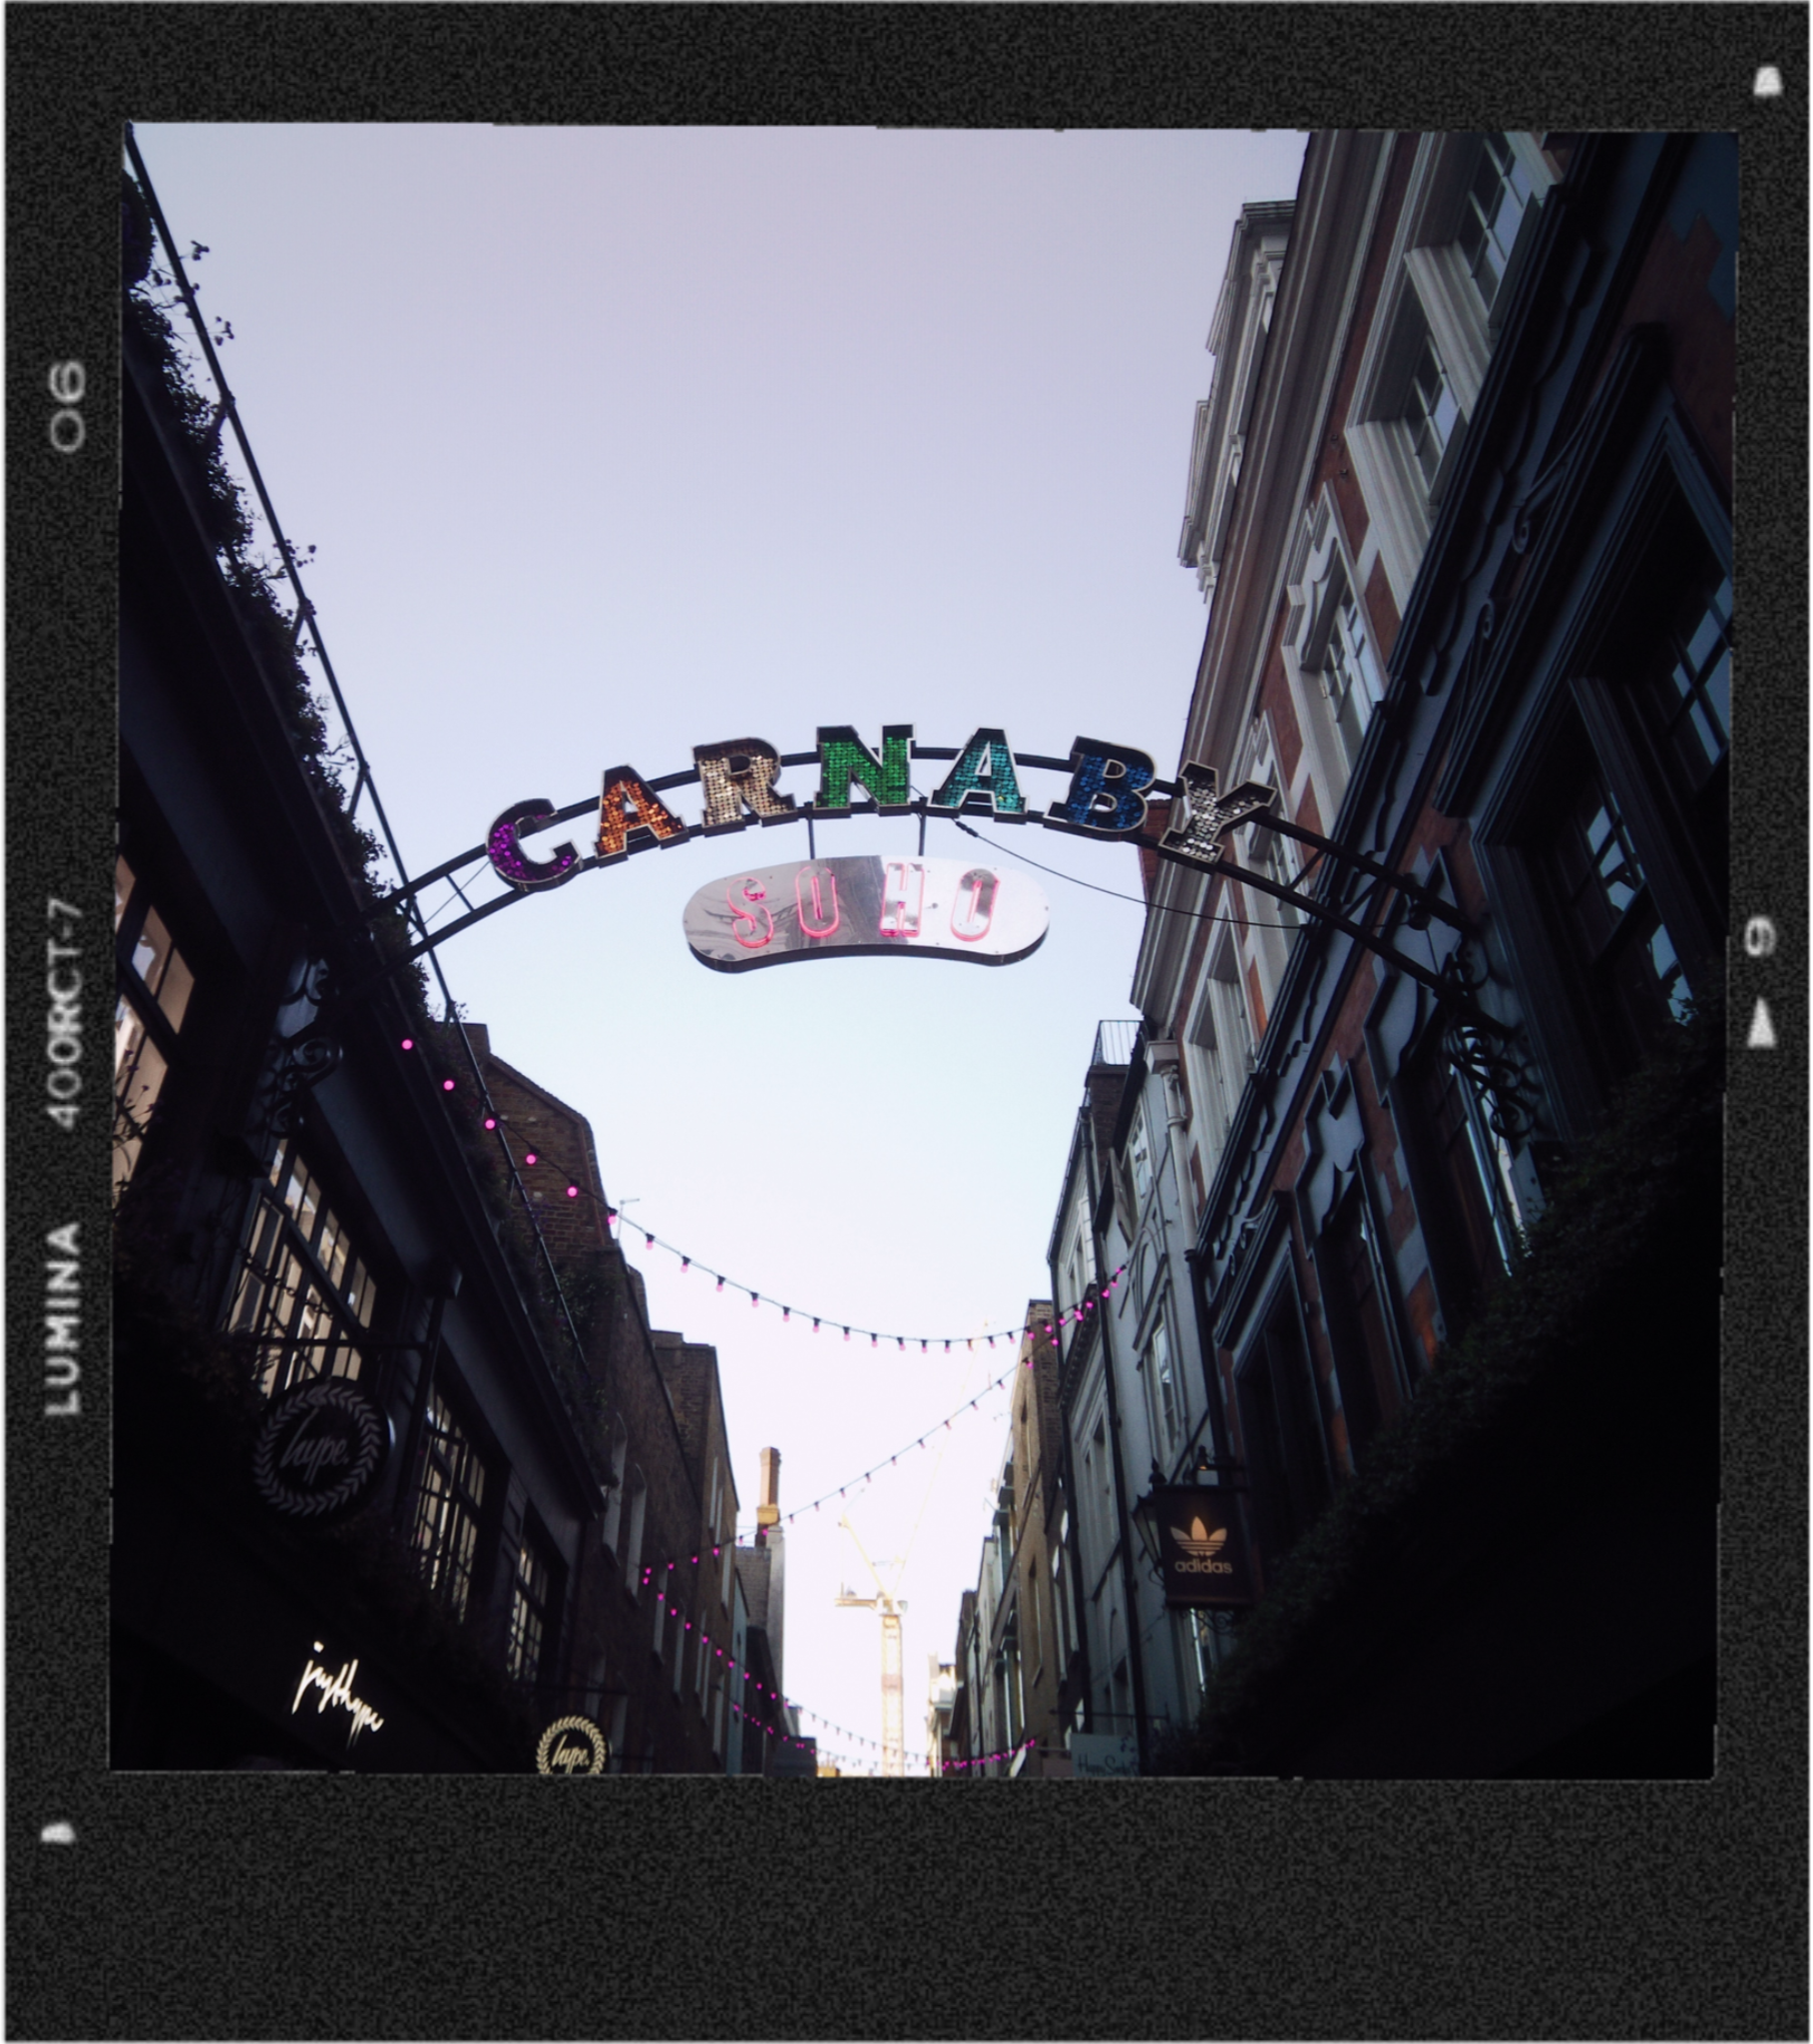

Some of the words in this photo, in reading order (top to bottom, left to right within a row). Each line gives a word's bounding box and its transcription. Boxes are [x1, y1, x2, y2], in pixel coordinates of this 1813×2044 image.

[485, 724, 1278, 892] CARNABY
[725, 860, 1001, 949] SOHO
[1174, 1558, 1233, 1575] adidas
